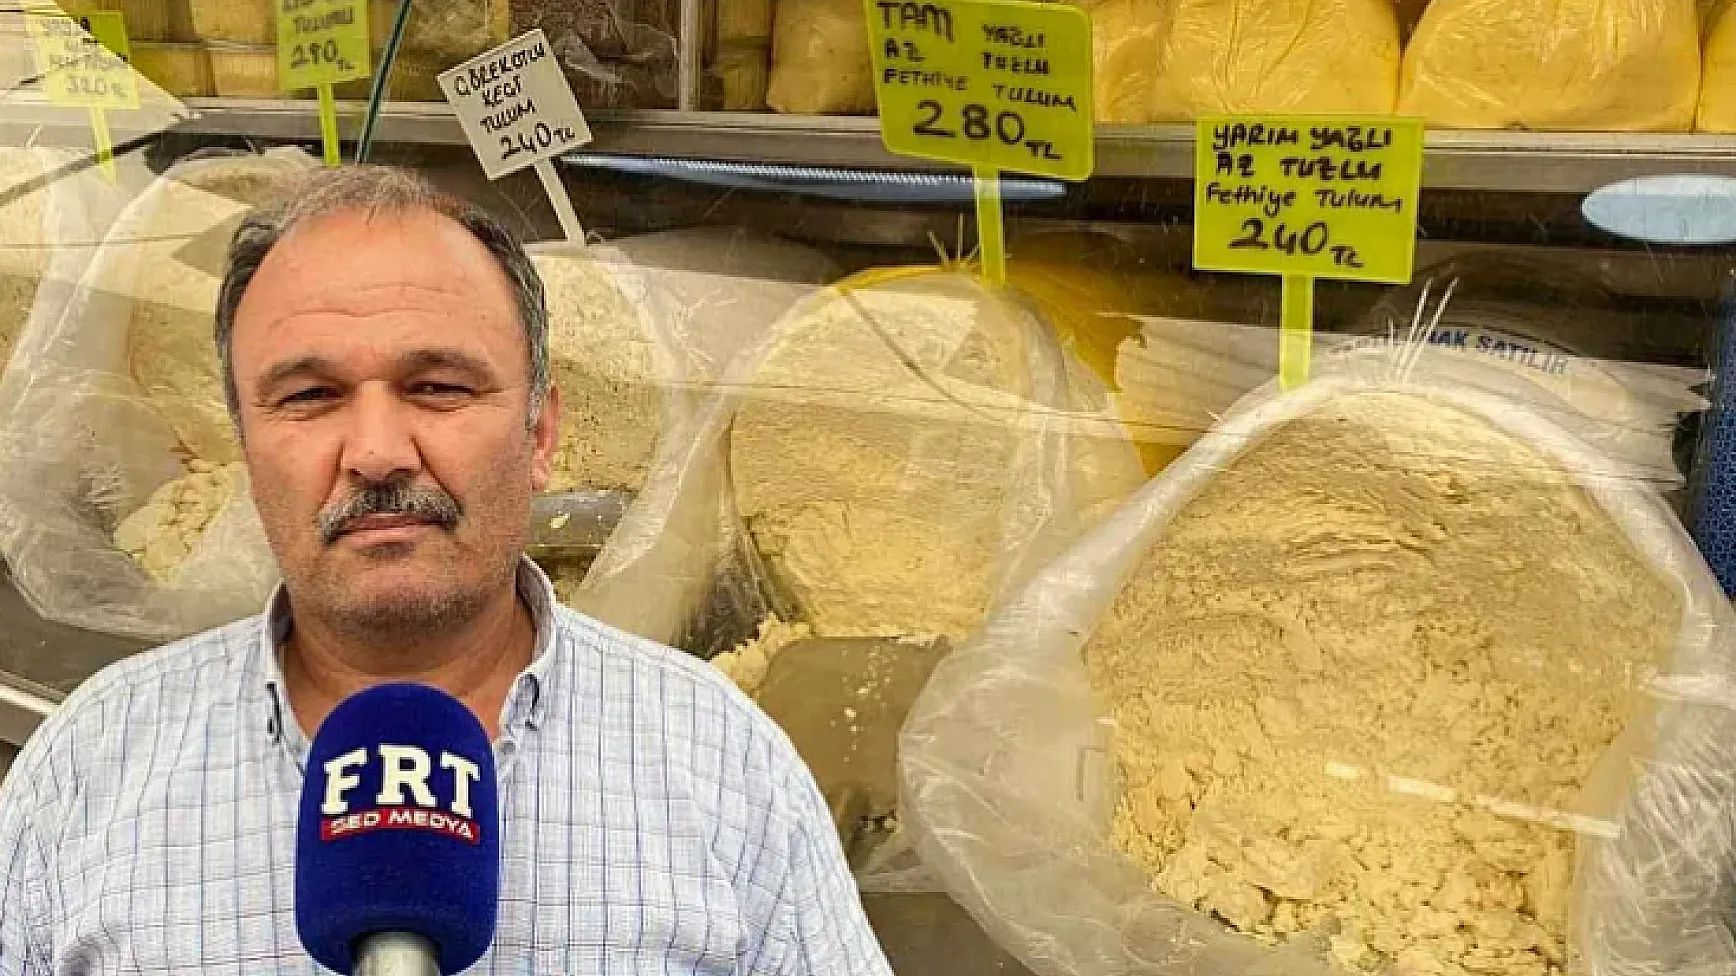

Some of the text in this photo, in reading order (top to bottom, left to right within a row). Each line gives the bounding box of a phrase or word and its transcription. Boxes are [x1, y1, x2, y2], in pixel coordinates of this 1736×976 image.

[876, 2, 955, 43] TAM
[884, 37, 925, 62] AZ
[500, 122, 551, 160] 240
[913, 99, 1025, 145] 280
[1212, 123, 1299, 151] YARIM
[1215, 151, 1382, 180] AZ TUZLU
[1227, 217, 1329, 256] 240
[321, 743, 481, 819] FRT
[388, 809, 474, 841] MEDYA
